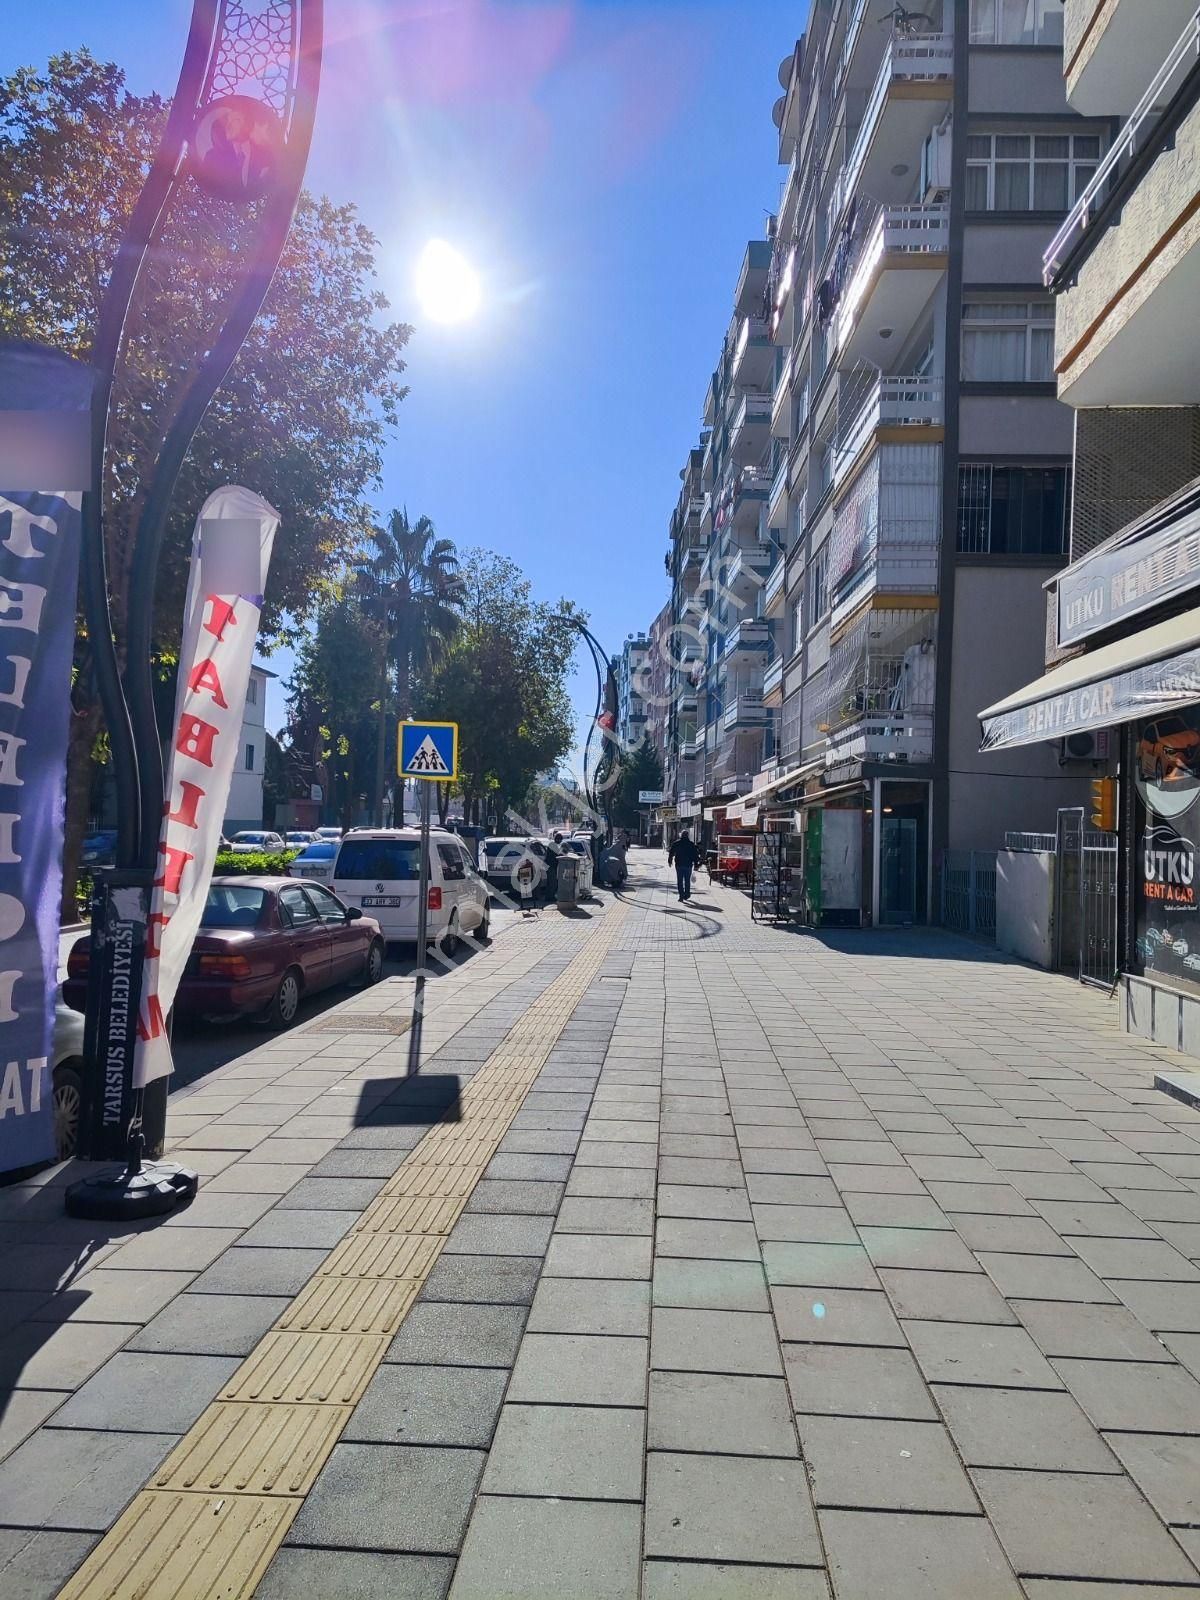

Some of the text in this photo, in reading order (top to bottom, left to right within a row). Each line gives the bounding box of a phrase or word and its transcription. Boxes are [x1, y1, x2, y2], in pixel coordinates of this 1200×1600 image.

[1066, 586, 1104, 630] UTKU
[1028, 700, 1062, 733] RENT
[1064, 694, 1077, 724] A
[1080, 683, 1115, 720] CAR
[1144, 850, 1194, 885] UTKU
[1144, 882, 1194, 903] RENT A CAR
[102, 919, 134, 1126] TARSUS BELEDİYESİ
